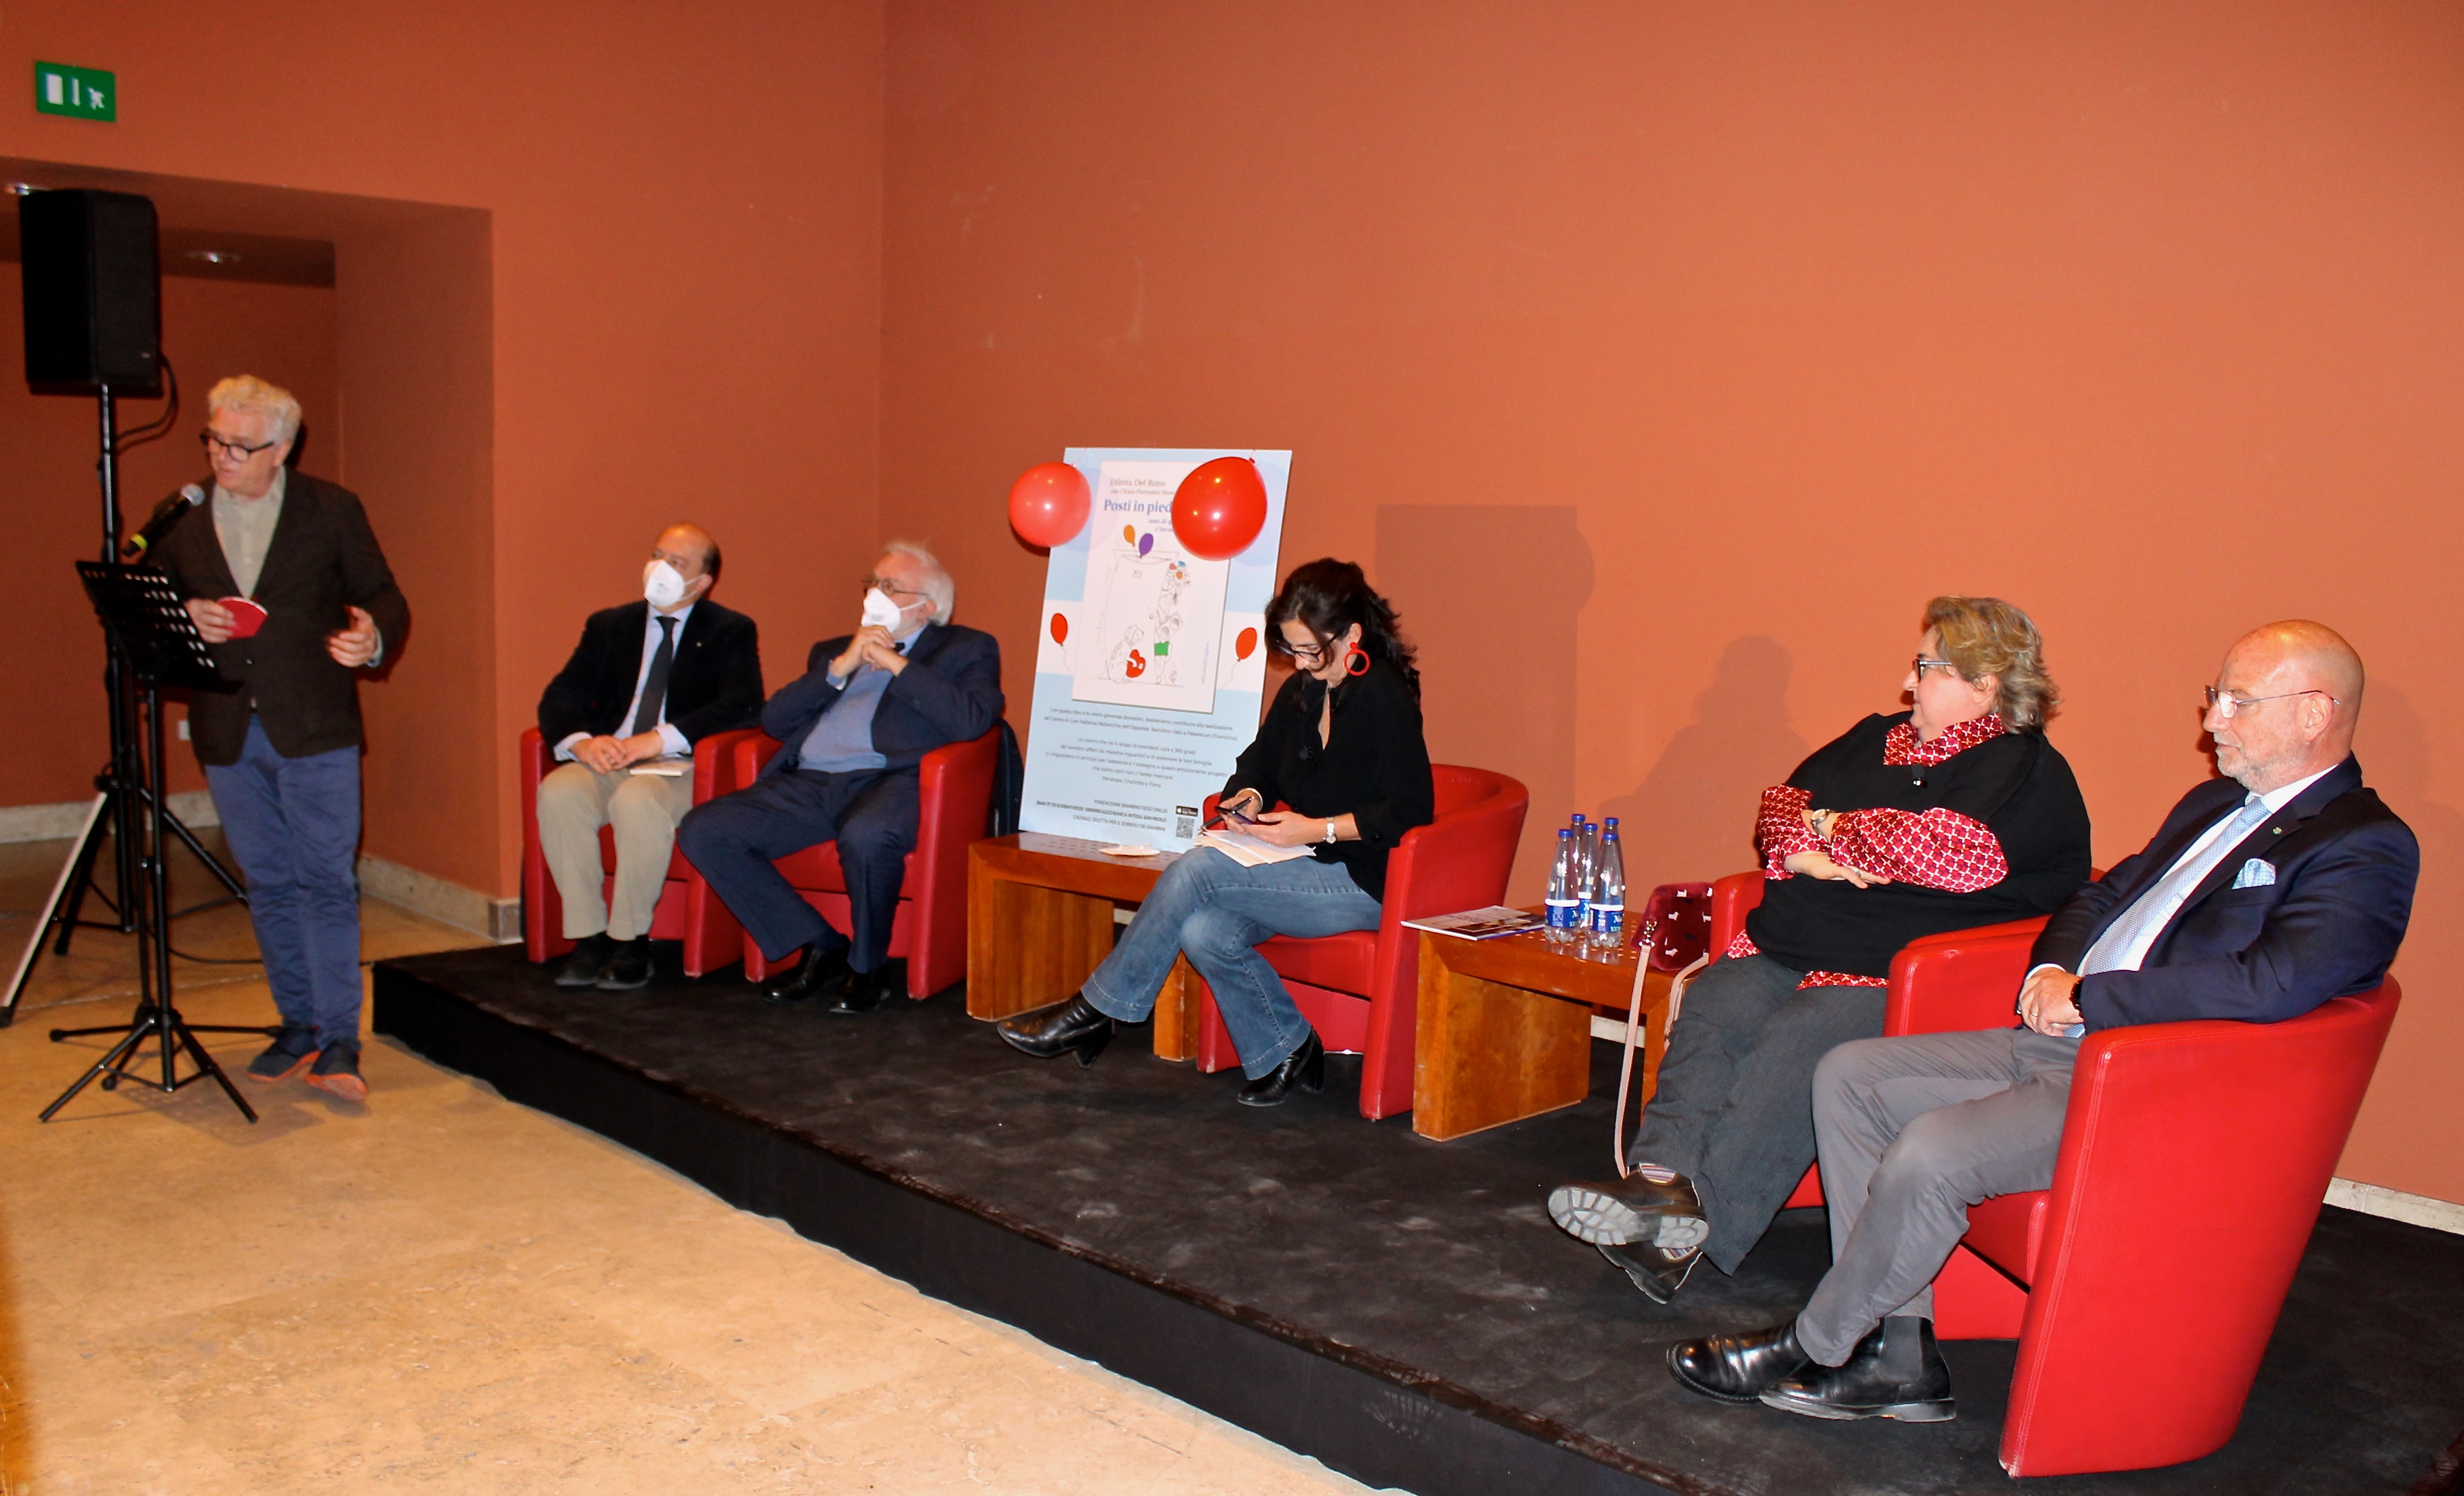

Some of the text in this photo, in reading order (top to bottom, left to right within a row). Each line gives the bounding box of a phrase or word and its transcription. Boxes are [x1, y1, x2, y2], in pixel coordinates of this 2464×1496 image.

[1104, 499, 1172, 516] Posti in pied
